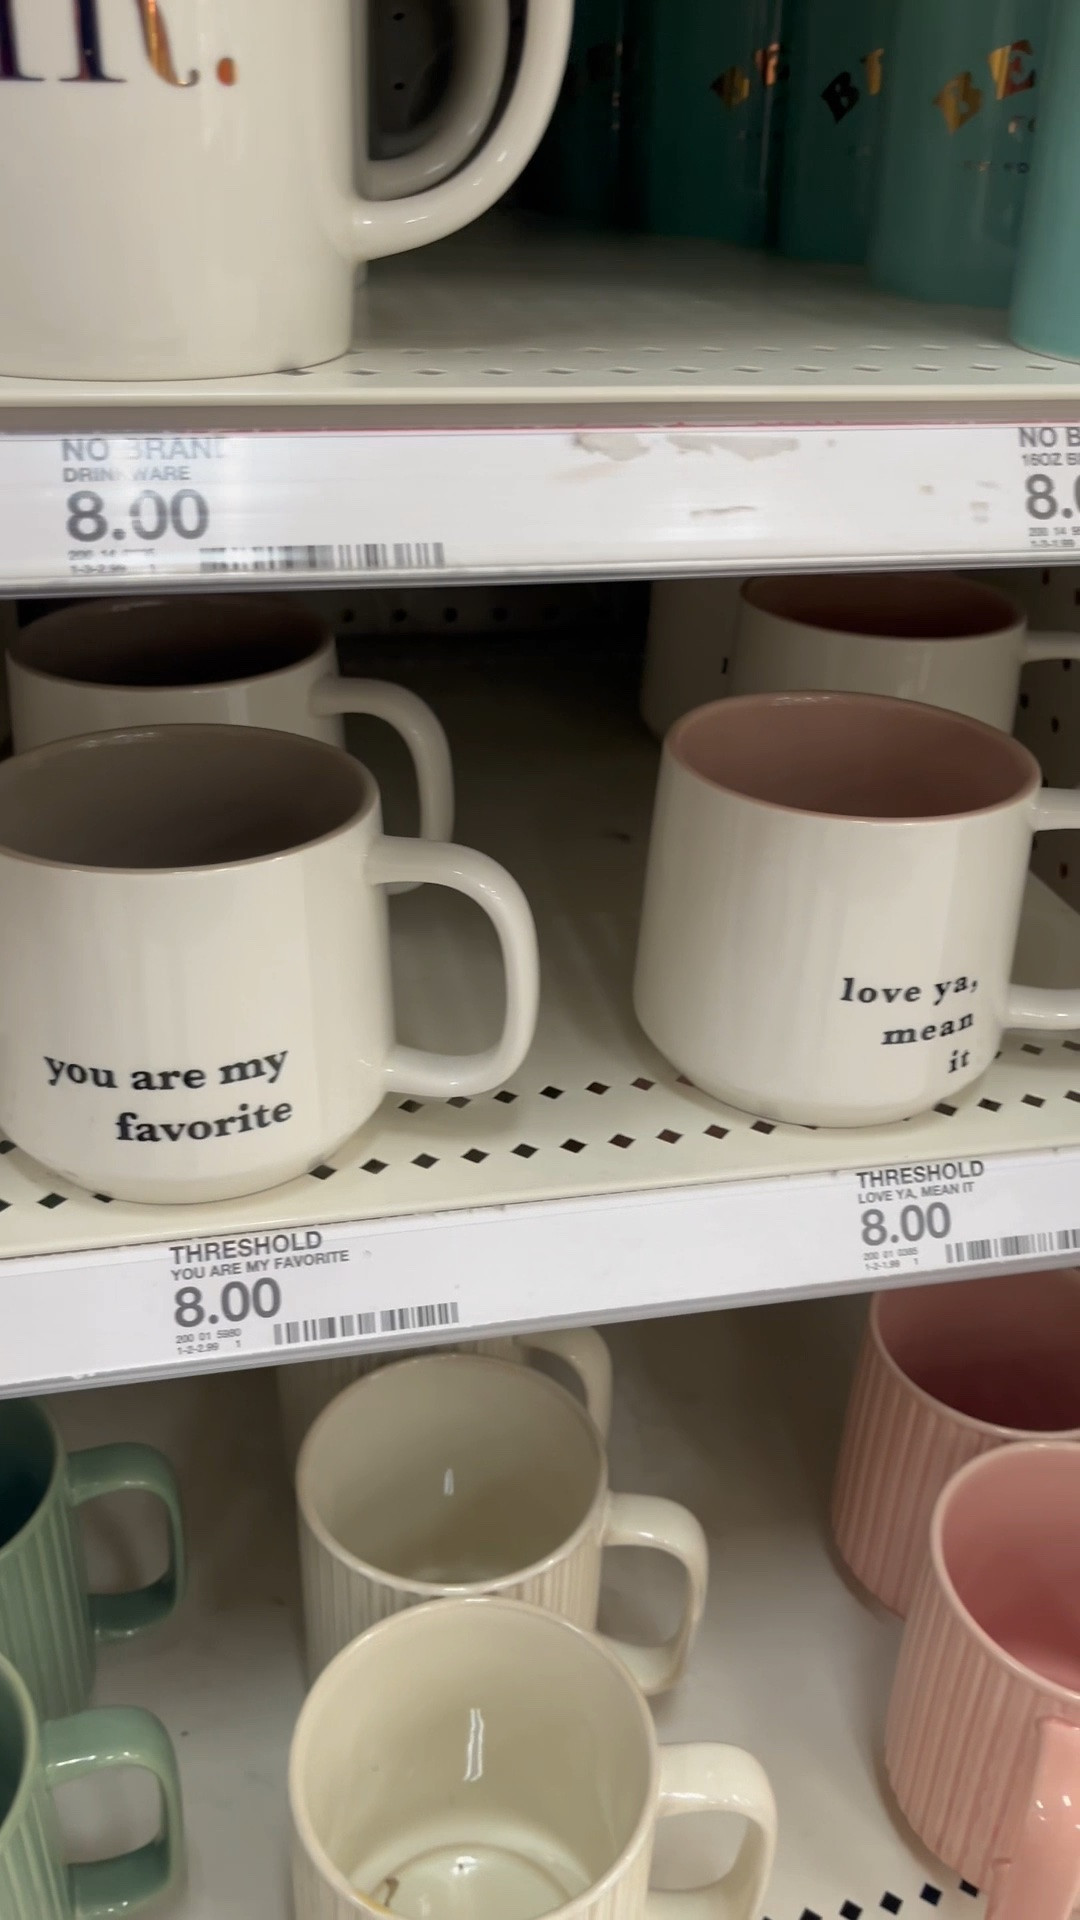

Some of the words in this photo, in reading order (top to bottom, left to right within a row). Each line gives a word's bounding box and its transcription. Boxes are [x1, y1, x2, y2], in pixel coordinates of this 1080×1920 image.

[62, 438, 110, 461] NO
[1018, 427, 1057, 447] NO
[63, 466, 191, 482] DRINWARE
[1025, 474, 1080, 520] 8.
[66, 489, 209, 541] 8.00
[840, 977, 921, 1003] love
[933, 976, 978, 1006] ya,
[880, 1013, 974, 1045] mean
[43, 1056, 117, 1088] you
[131, 1068, 206, 1090] are
[218, 1050, 288, 1083] my
[948, 1050, 971, 1073] it
[116, 1102, 293, 1141] favorite
[856, 1160, 984, 1188] THRESHOLD
[858, 1190, 892, 1204] LOVE
[921, 1183, 959, 1197] MEAN
[963, 1181, 975, 1193] IT
[861, 1202, 951, 1246] 8.00
[170, 1230, 323, 1264] THRESHOLD
[171, 1267, 206, 1281] YOU
[209, 1262, 242, 1277] ARE
[246, 1259, 270, 1273] MY
[274, 1250, 350, 1269] FAVORITE
[174, 1277, 282, 1327] 8.00
